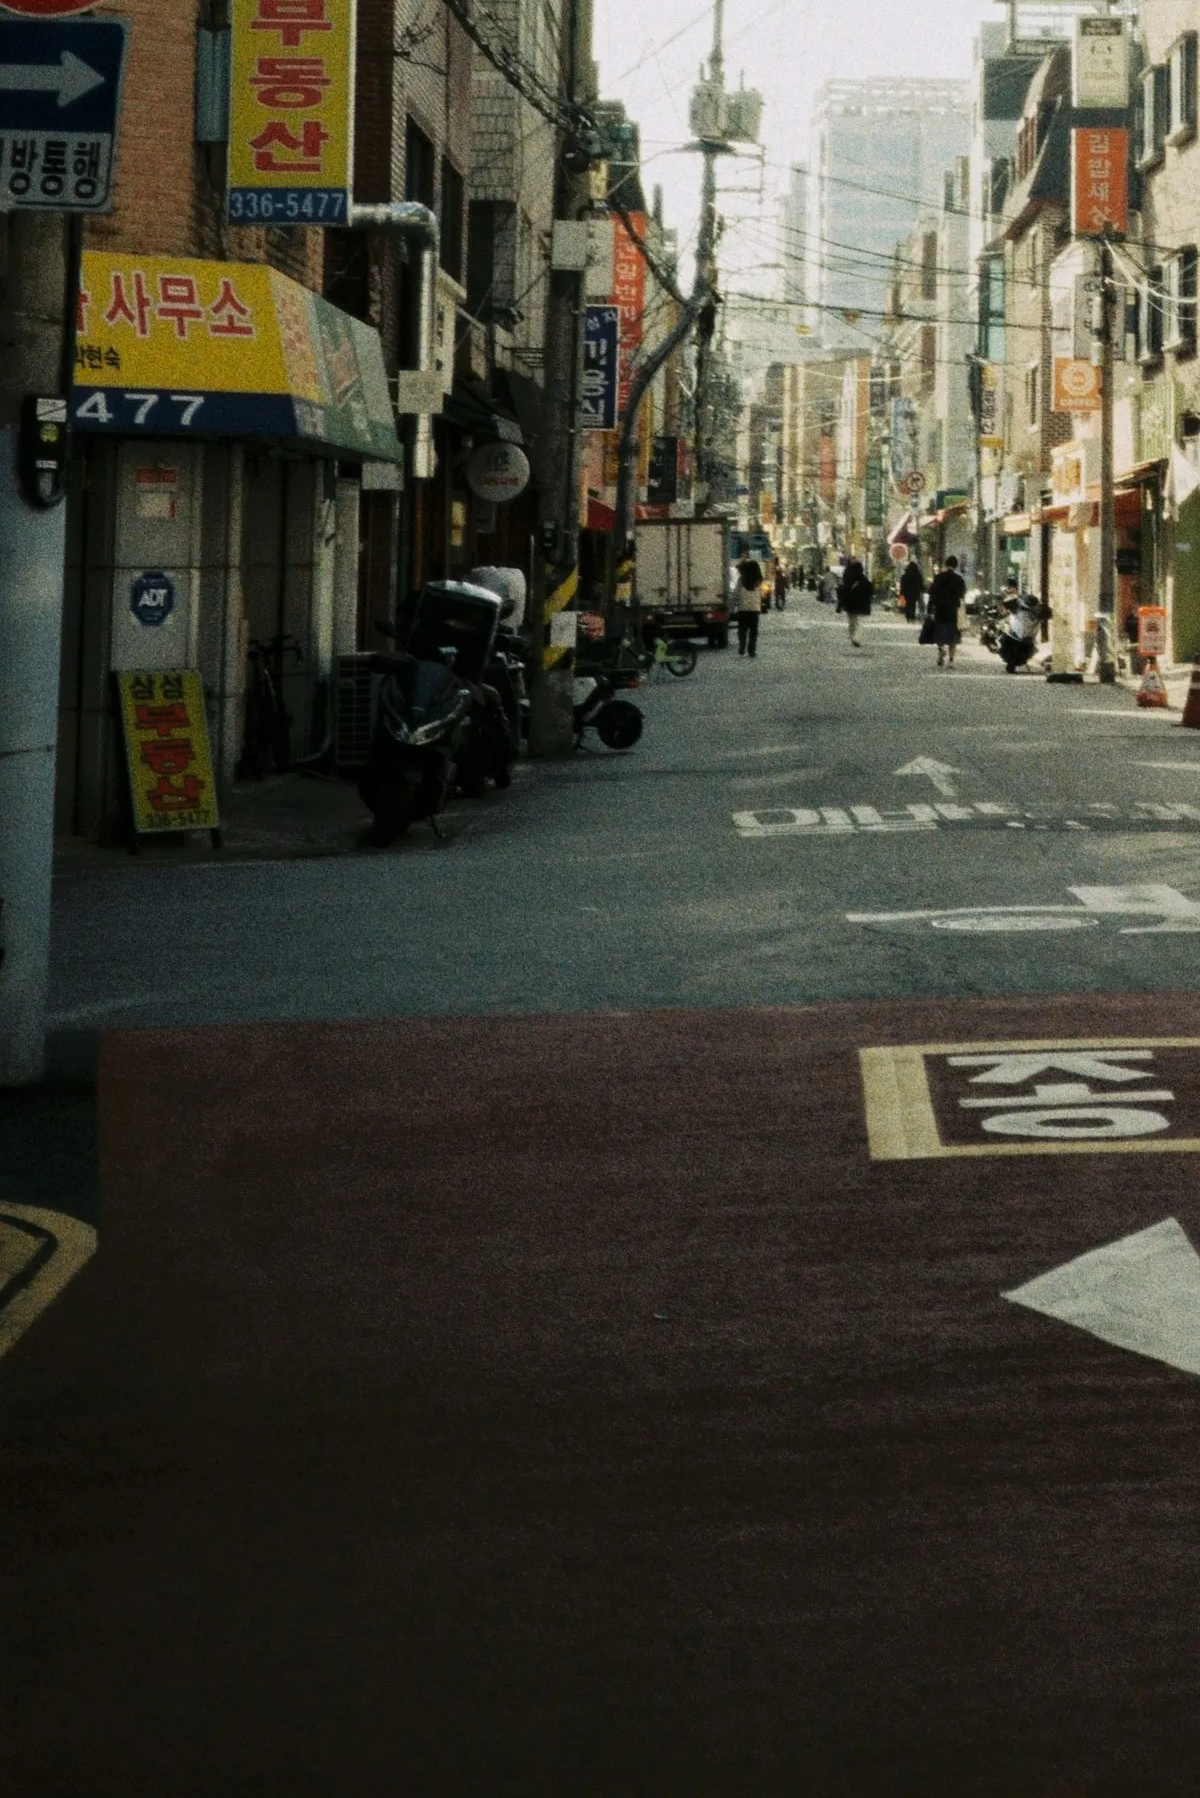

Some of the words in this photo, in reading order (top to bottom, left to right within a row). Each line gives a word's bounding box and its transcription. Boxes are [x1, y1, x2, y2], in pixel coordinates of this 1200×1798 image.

[229, 190, 345, 219] 336-5477
[138, 588, 168, 608] ADT
[135, 703, 205, 811] 부동산
